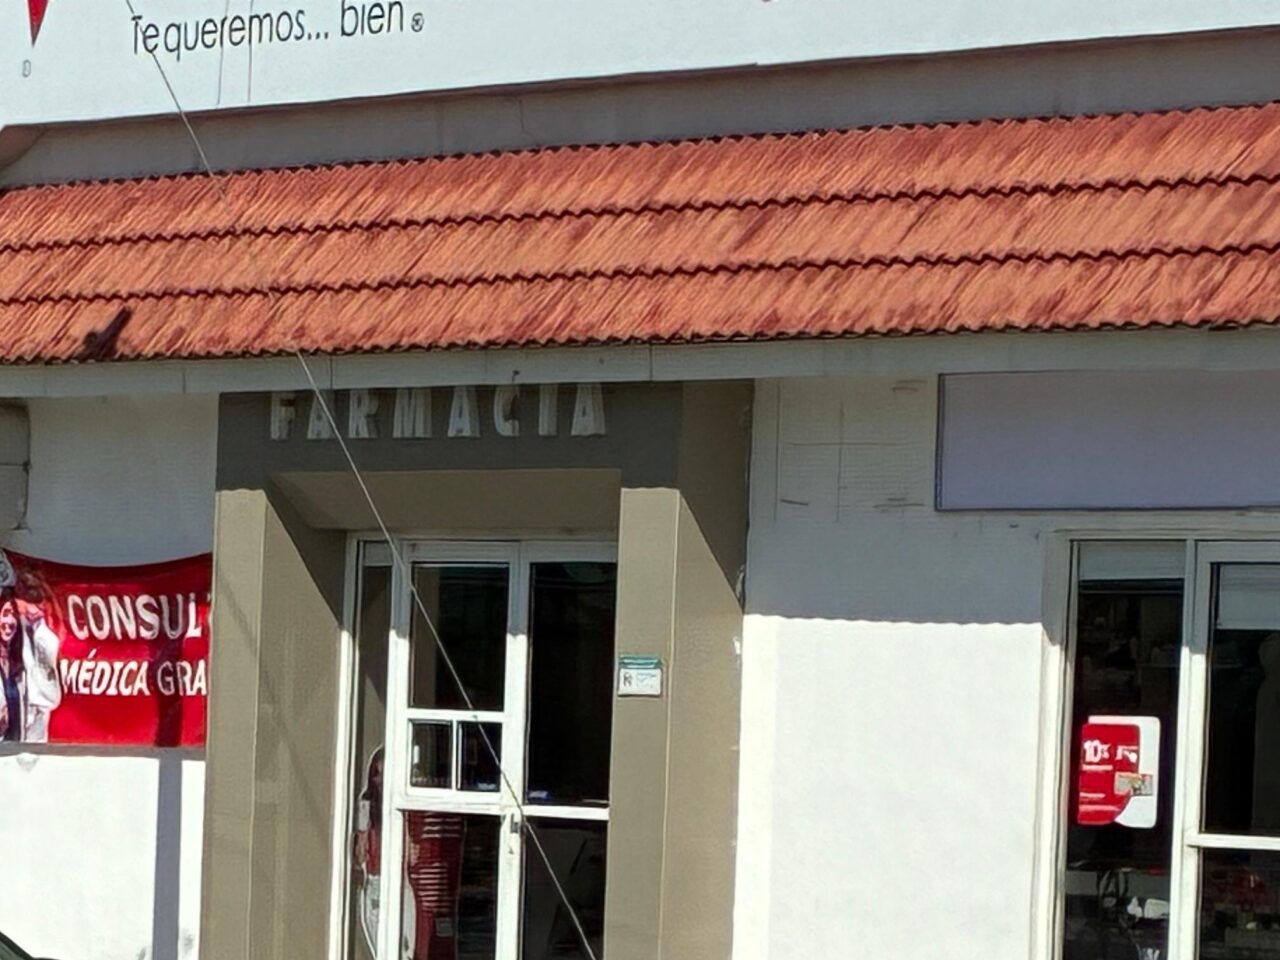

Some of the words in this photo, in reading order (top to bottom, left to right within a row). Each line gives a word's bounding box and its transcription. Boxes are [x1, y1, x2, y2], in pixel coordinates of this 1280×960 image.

[340, 0, 404, 37] bien
[271, 384, 606, 439] FARMACIA
[66, 592, 211, 640] CONSUL
[60, 649, 151, 697] MÉDICA
[156, 659, 207, 696] GRA
